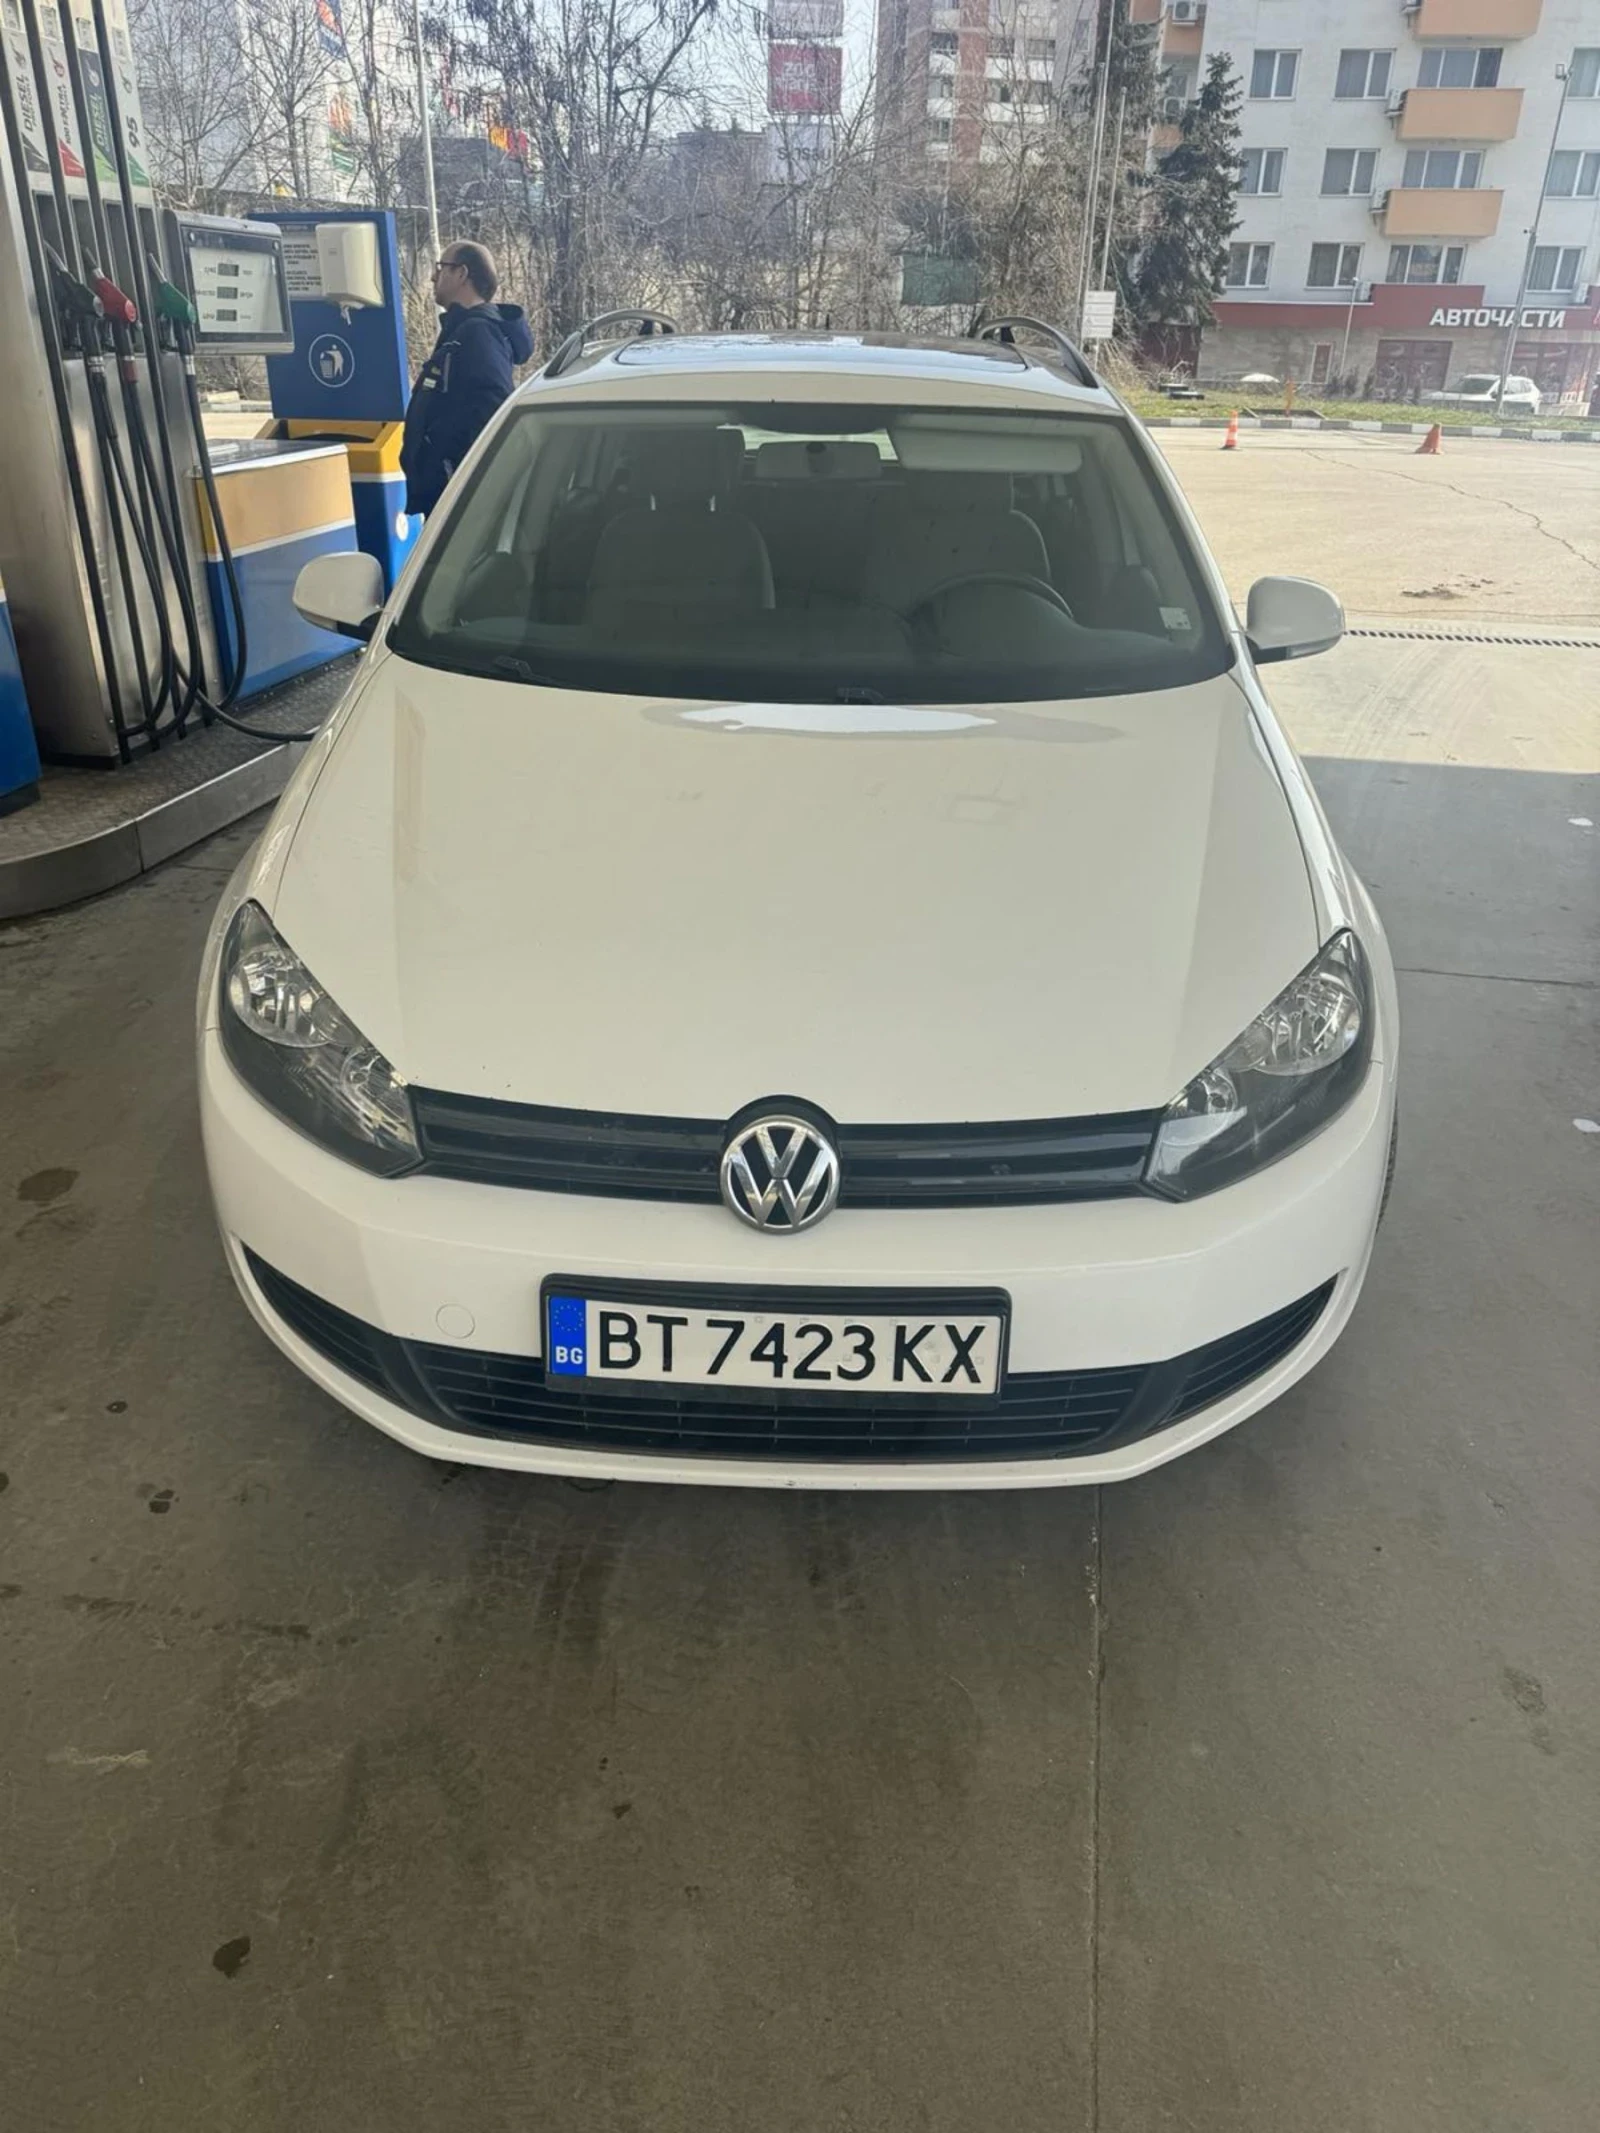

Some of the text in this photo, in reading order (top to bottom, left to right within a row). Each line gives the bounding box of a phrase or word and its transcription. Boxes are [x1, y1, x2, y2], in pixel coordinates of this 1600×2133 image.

[16, 75, 34, 132] DIESEL
[90, 93, 108, 149] DIESEL
[127, 116, 141, 149] 95
[555, 1345, 584, 1365] BG
[599, 1310, 986, 1384] BT 7423 KX
